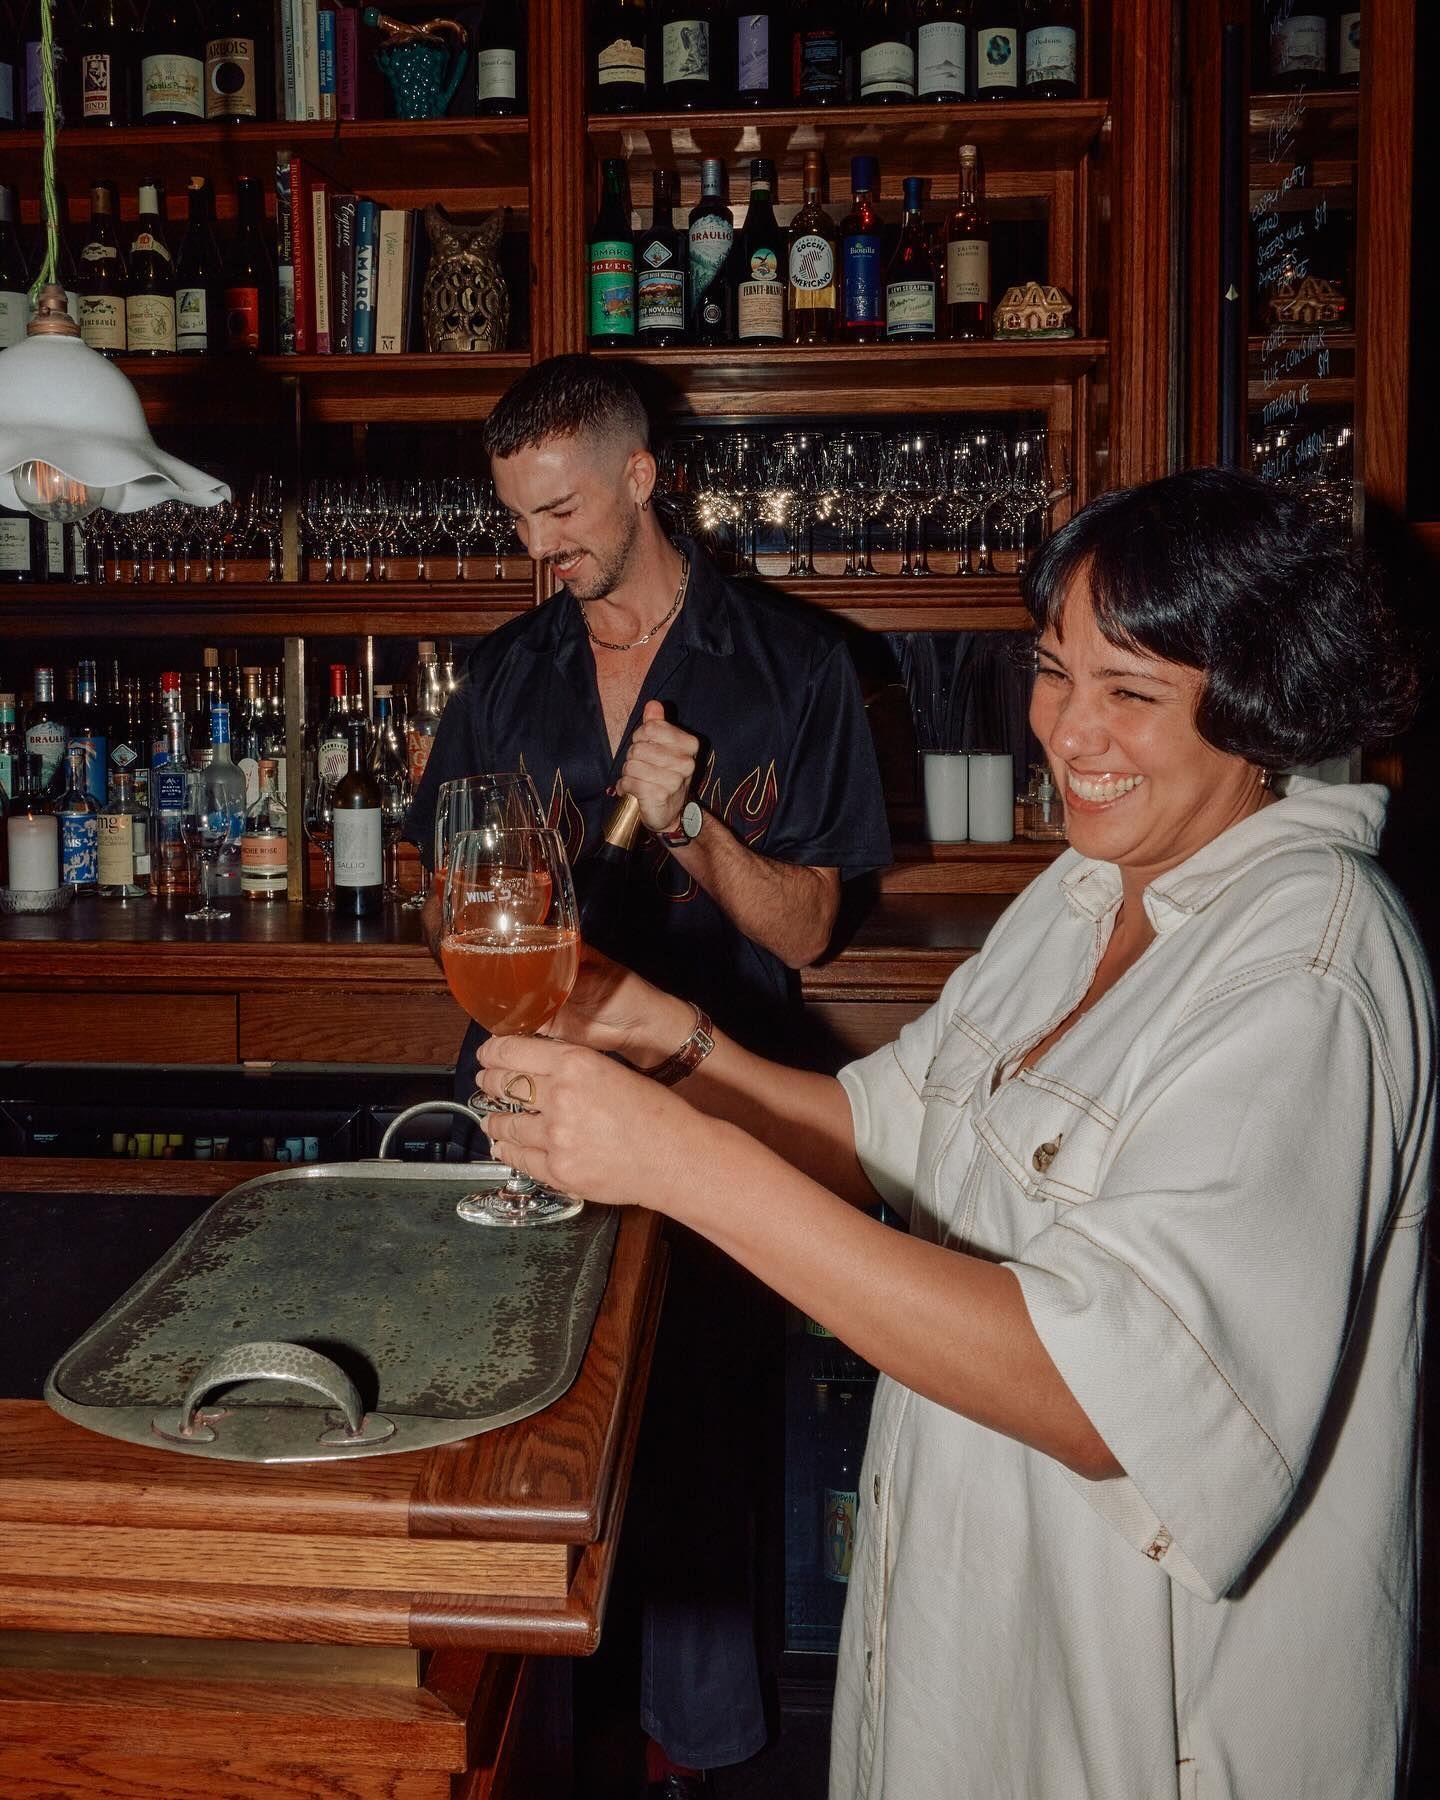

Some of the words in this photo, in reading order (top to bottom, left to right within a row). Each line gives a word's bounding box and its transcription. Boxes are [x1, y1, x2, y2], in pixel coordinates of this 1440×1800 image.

[208, 41, 249, 60] ARBOIS
[281, 212, 291, 230] James
[691, 231, 732, 242] BRAULIO
[593, 249, 629, 257] AMARO
[797, 242, 825, 253] COCCHI
[356, 243, 369, 311] AMARO
[792, 272, 831, 288] AMERICANO
[466, 891, 496, 904] WINE
